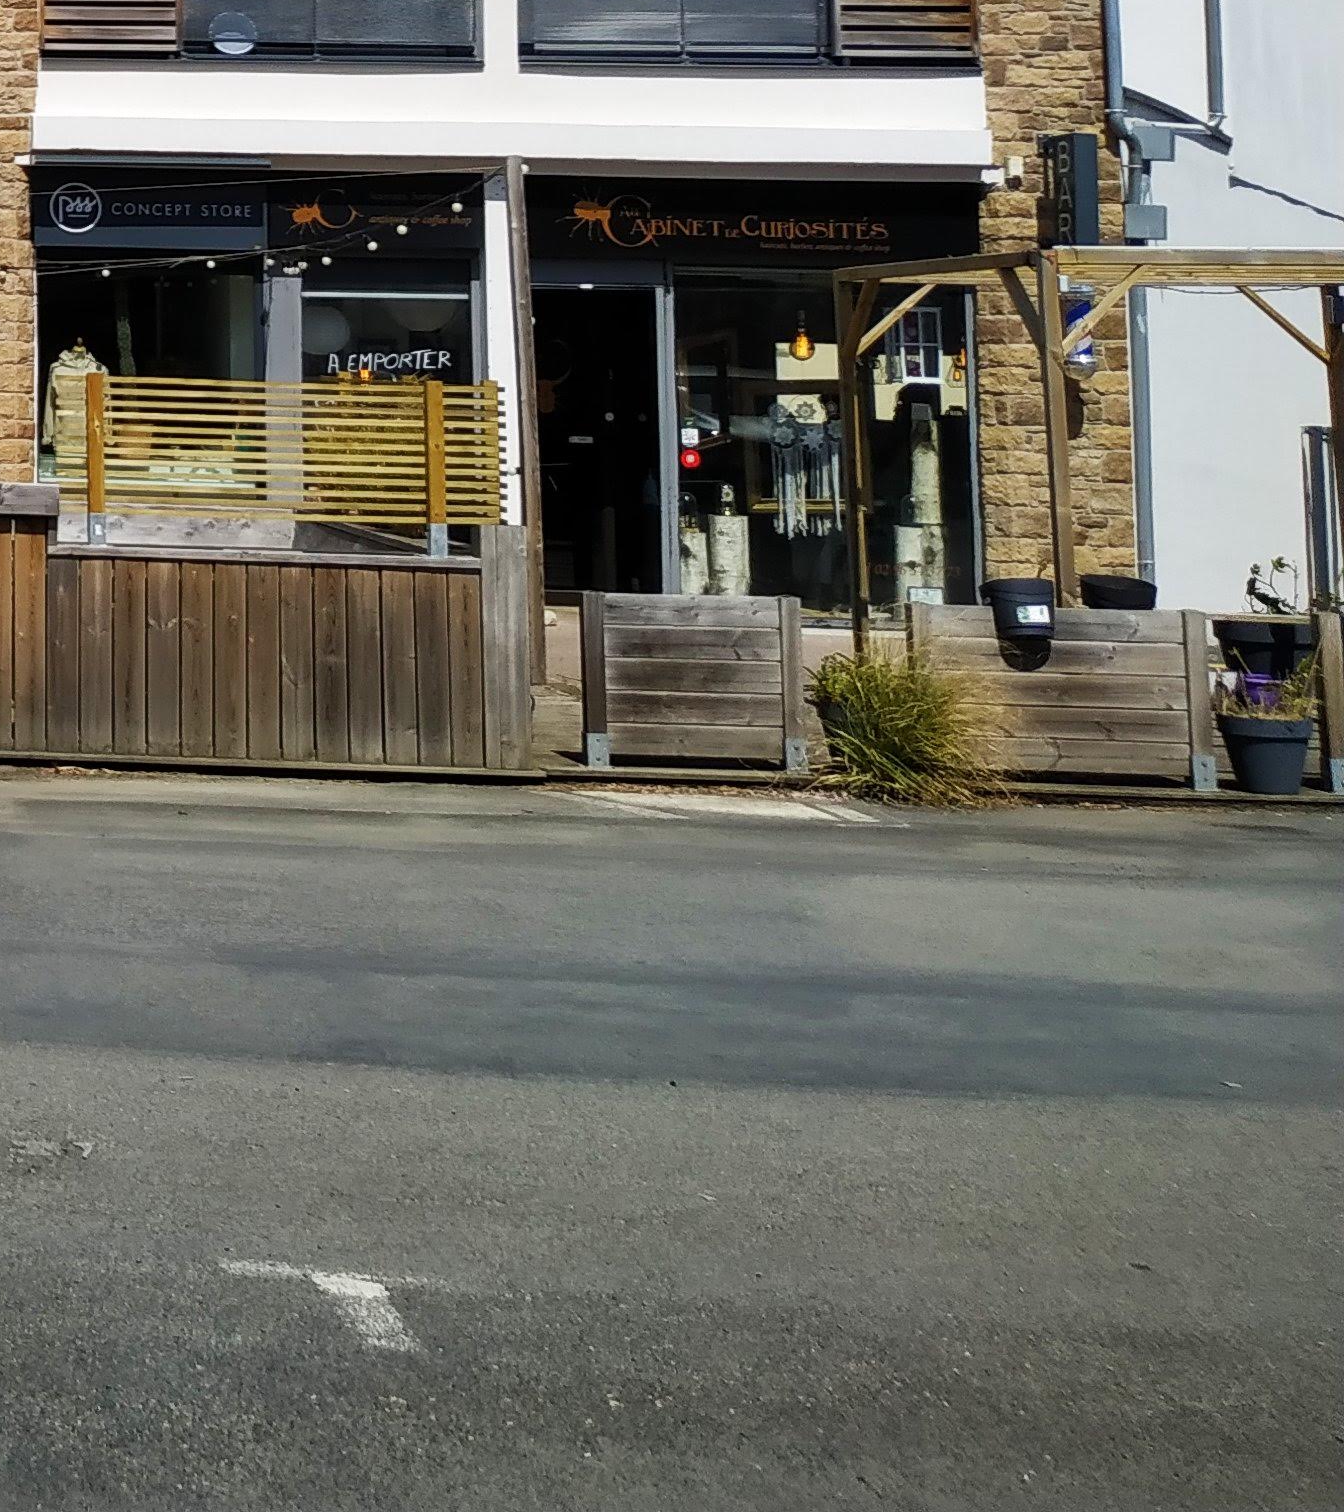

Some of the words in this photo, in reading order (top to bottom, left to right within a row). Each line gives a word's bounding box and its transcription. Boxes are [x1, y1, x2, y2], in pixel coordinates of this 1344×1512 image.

[1057, 140, 1073, 244] BAR
[111, 202, 192, 217] CONCEPT
[200, 203, 252, 218] STORE
[327, 353, 340, 374] A
[347, 348, 452, 373] EMPORTER
